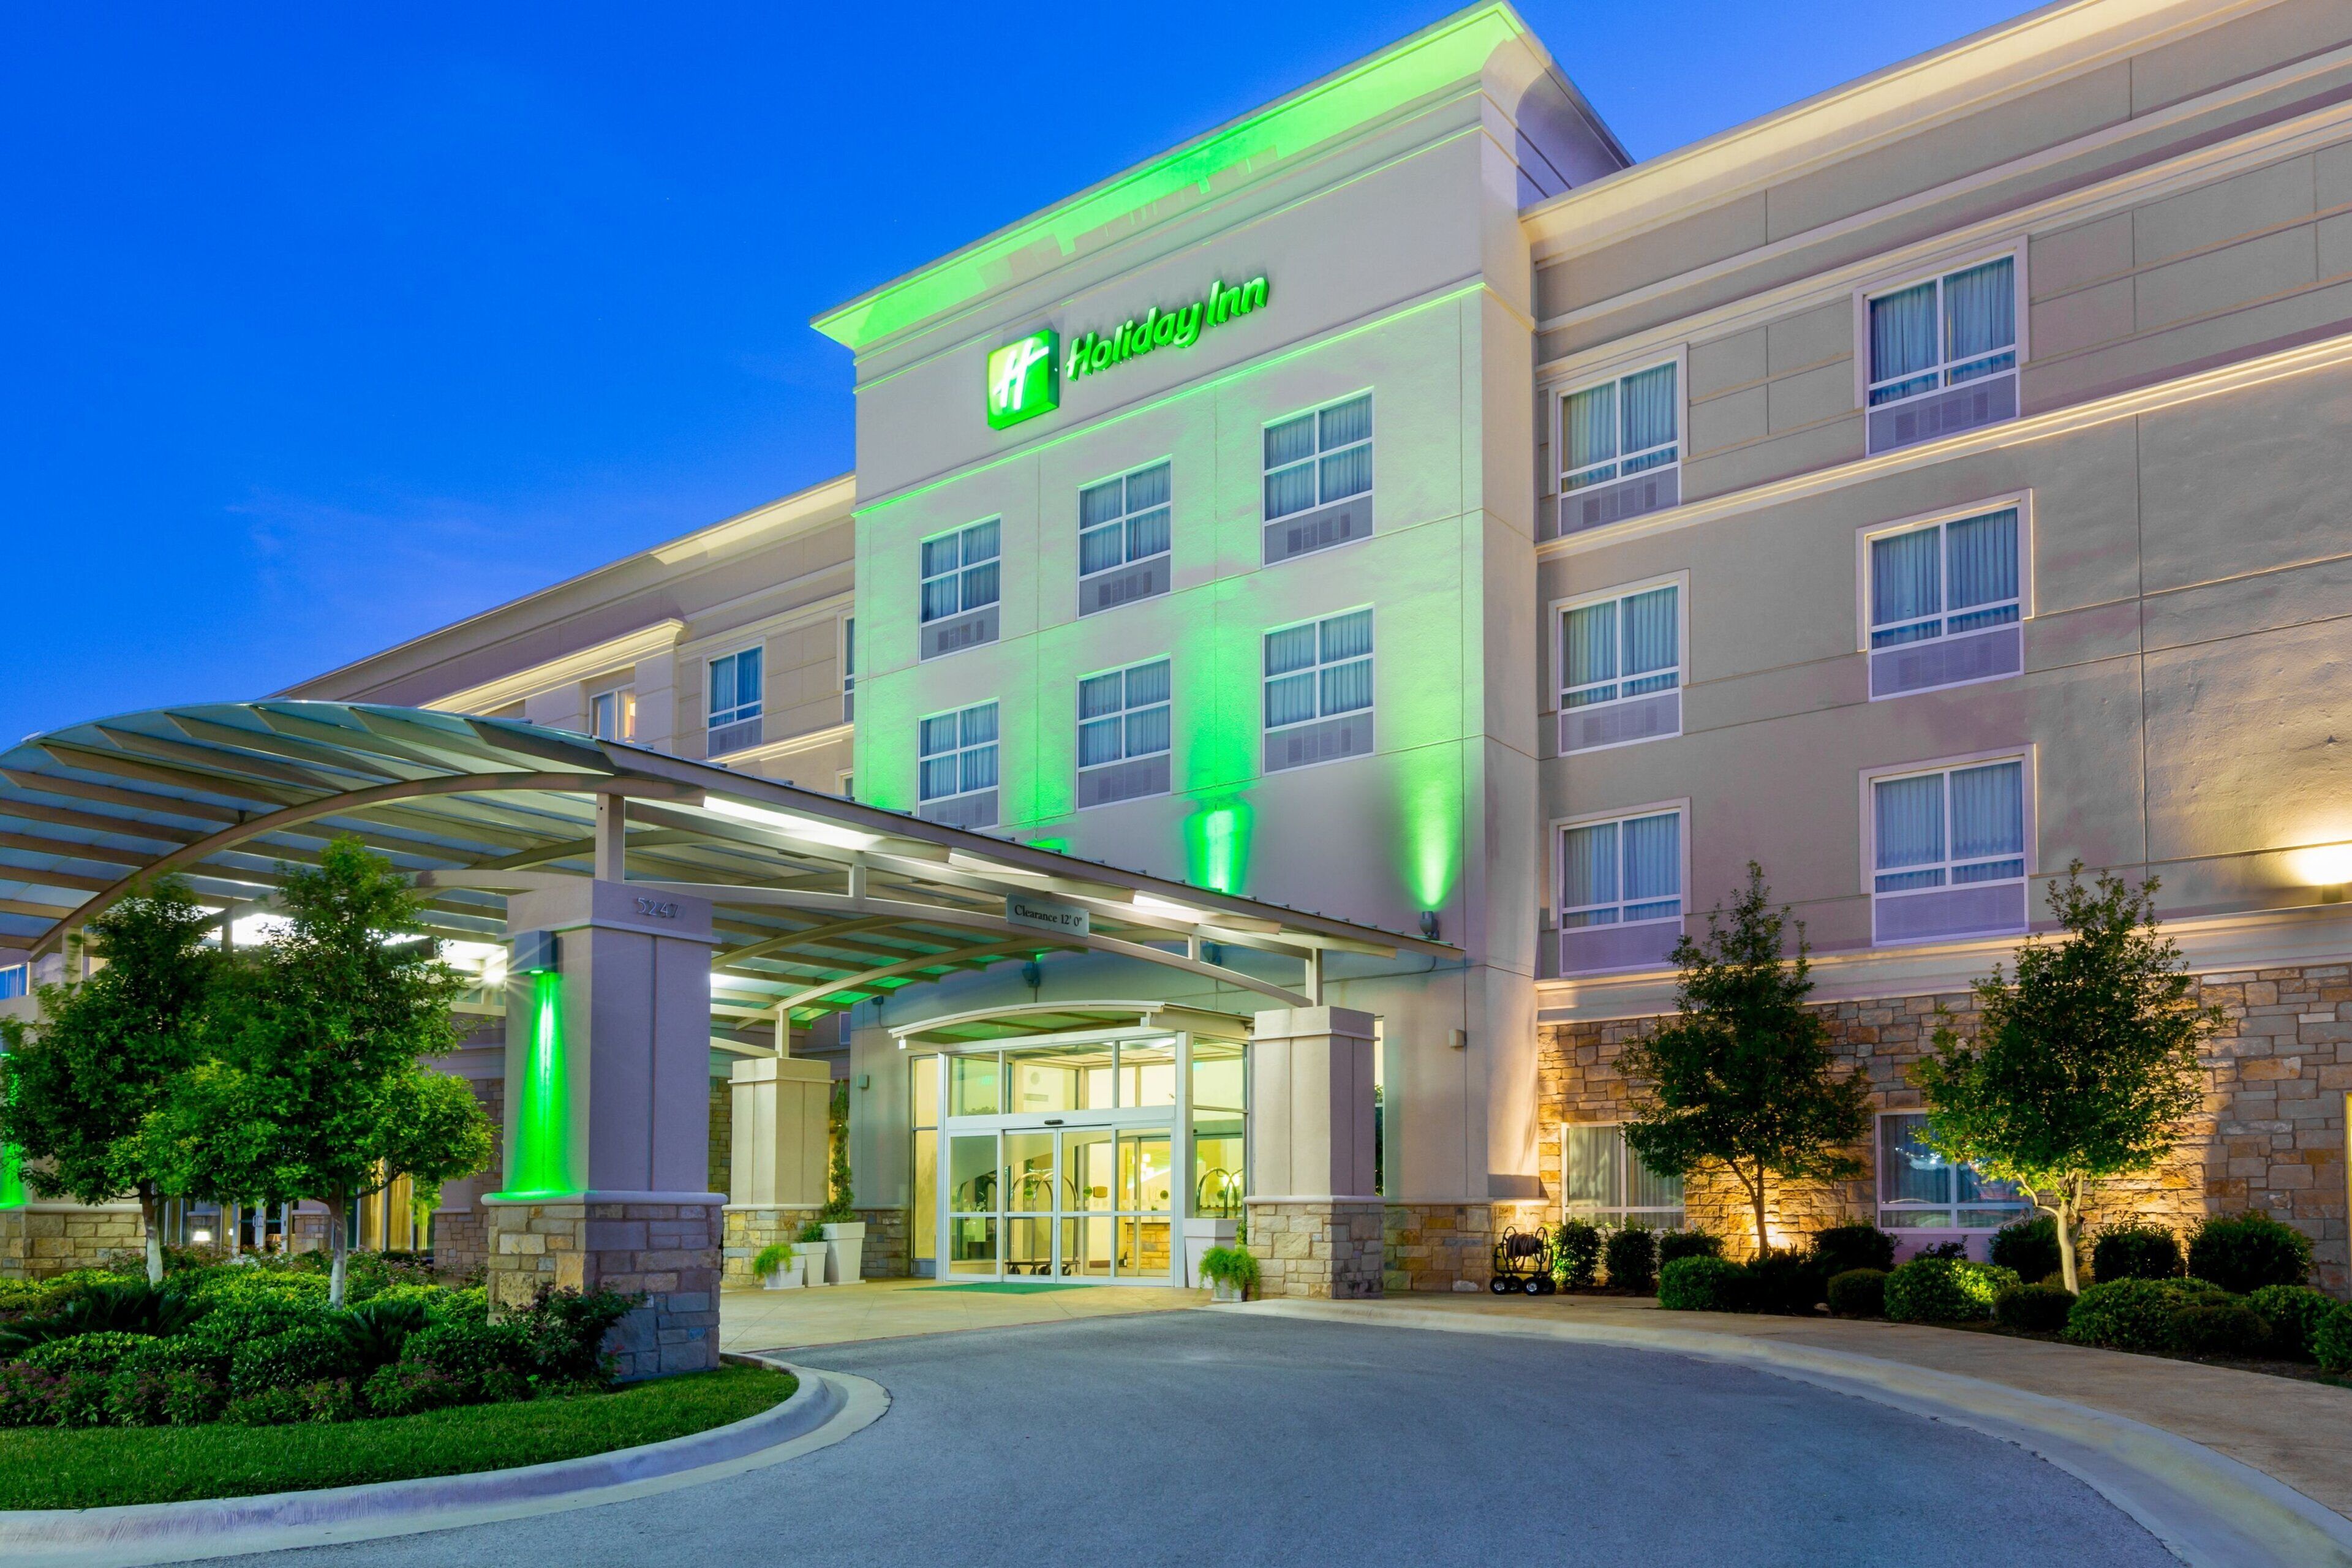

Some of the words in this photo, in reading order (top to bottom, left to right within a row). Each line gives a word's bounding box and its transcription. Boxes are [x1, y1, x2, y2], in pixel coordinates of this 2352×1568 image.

[1065, 301, 1204, 382] Holiday
[1207, 277, 1269, 327] Inn
[638, 897, 679, 918] 5247
[1014, 905, 1057, 922] Clearance
[1061, 914, 1071, 925] 12'
[1074, 916, 1082, 927] 0"
